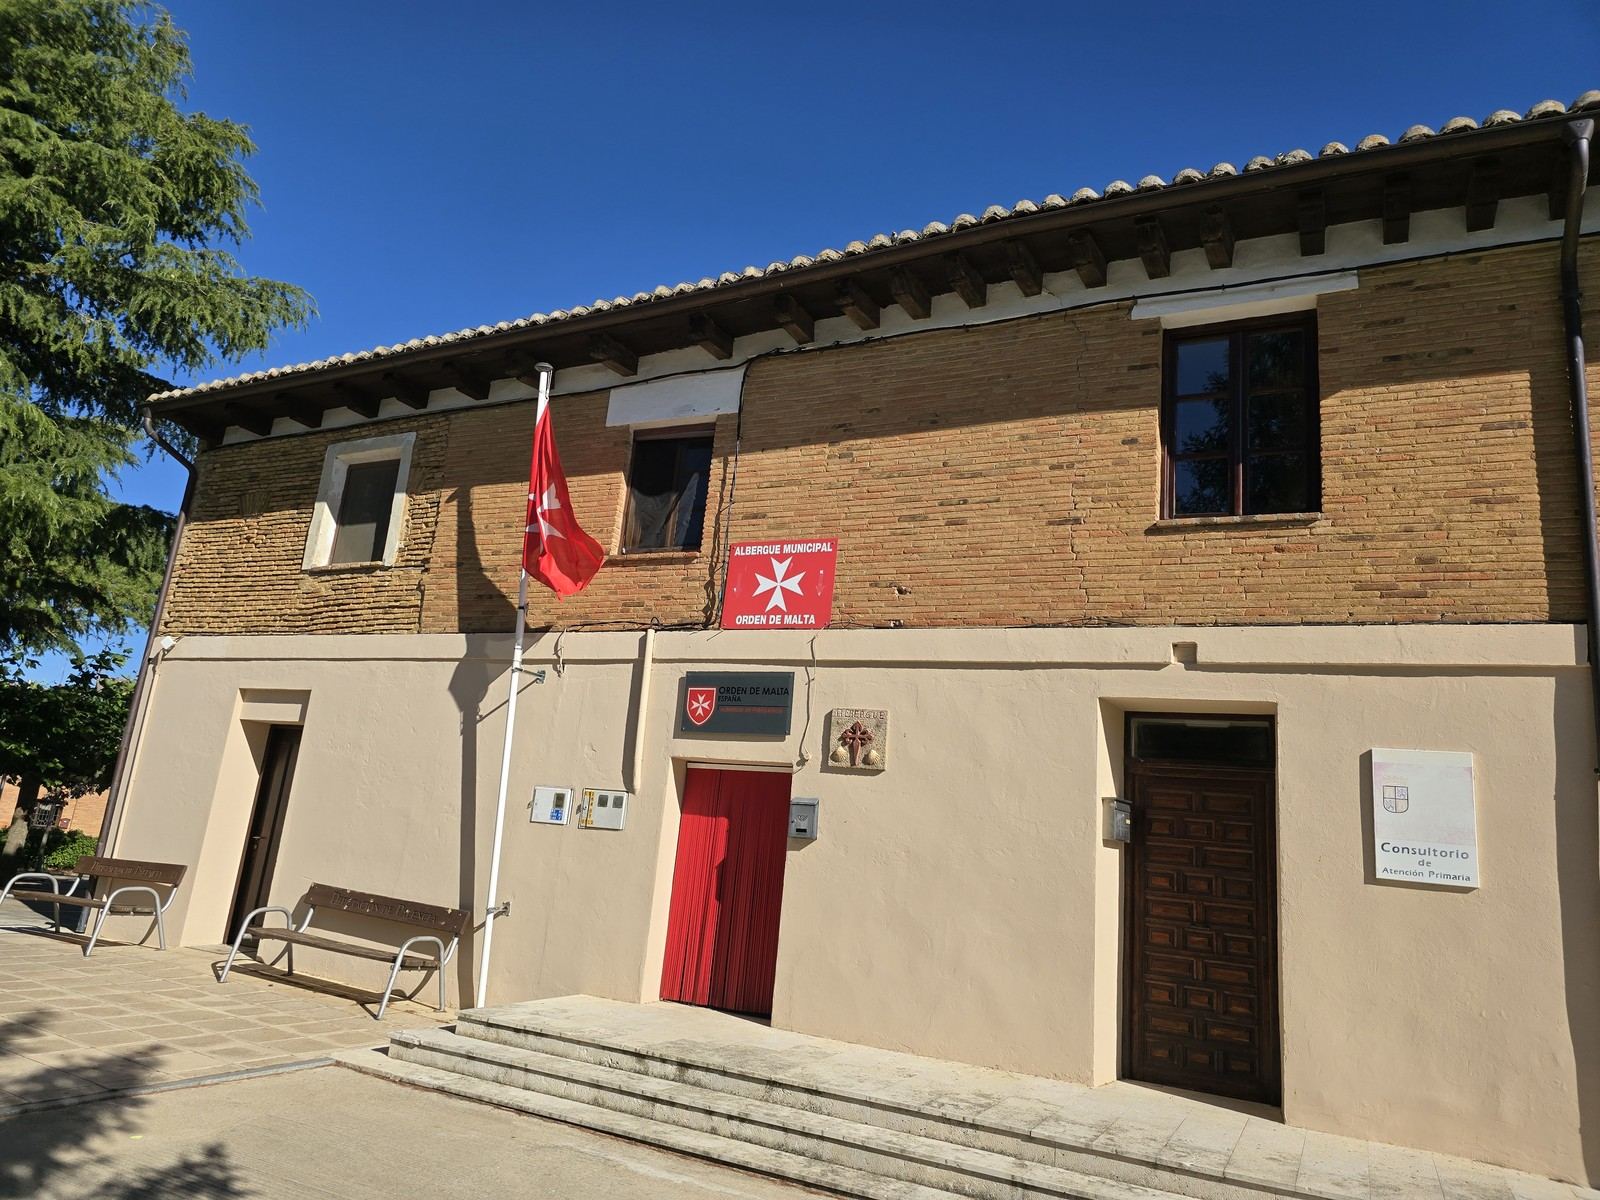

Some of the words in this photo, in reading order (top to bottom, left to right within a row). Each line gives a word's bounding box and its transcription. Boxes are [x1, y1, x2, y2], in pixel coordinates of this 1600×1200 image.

[734, 545, 781, 556] ALBERGUE
[783, 542, 833, 554] MUNICIPAL
[735, 615, 766, 625] ORDEN
[768, 615, 782, 625] DE
[783, 614, 816, 625] MALTA
[718, 686, 747, 695] ORDEN
[749, 687, 761, 695] DE
[762, 687, 790, 696] MALTA
[718, 695, 742, 703] ESPAÑA
[1380, 842, 1470, 860] Consultorio
[1418, 859, 1432, 867] de
[1382, 867, 1424, 877] Atención
[1428, 871, 1471, 882] Primaria
